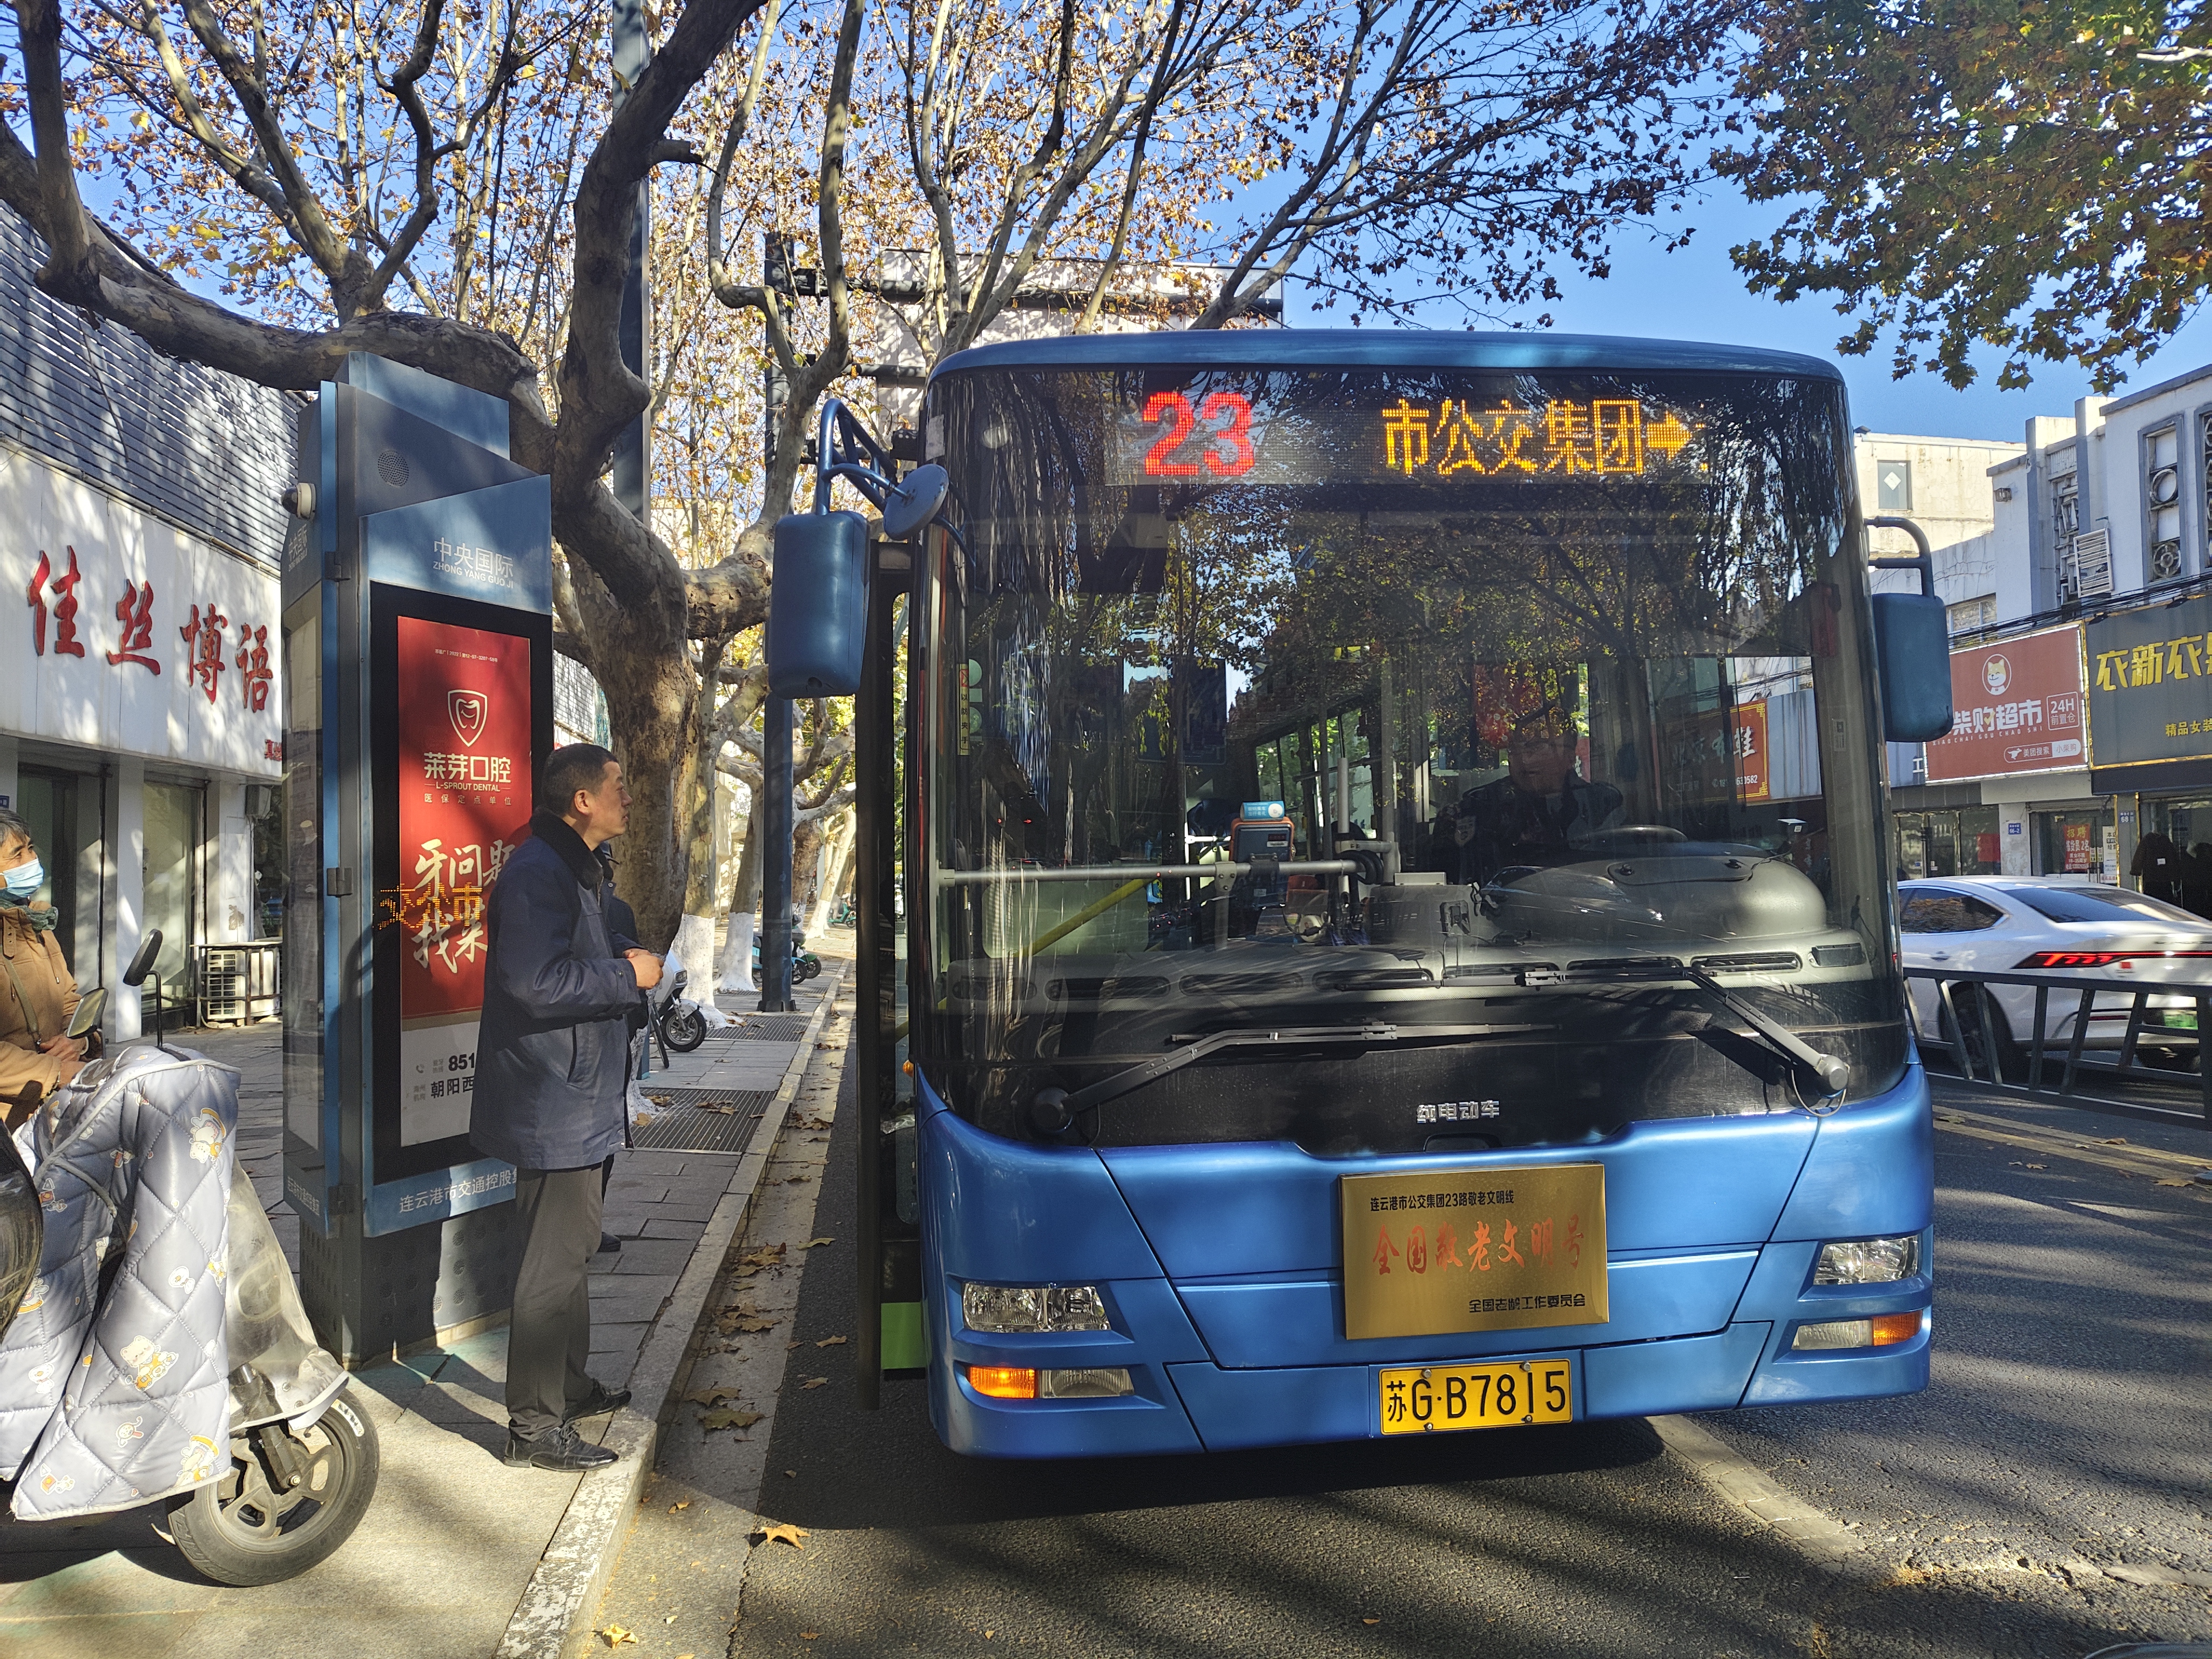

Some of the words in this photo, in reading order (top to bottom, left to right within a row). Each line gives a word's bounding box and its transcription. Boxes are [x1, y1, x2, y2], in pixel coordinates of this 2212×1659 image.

[1143, 392, 1254, 476] 23
[1382, 398, 1644, 476] 市公交集团
[434, 537, 514, 578] 中央国际
[433, 561, 463, 576] ZHONG
[464, 568, 486, 581] YANG
[488, 575, 505, 586] GUO
[507, 578, 514, 589] JI
[2096, 632, 2212, 691] 衣新衣
[2051, 698, 2074, 713] 24H
[1948, 699, 2042, 736] 柴购超市
[2051, 712, 2076, 725] 前置仓
[2165, 718, 2212, 737] 精品女装
[1999, 729, 2021, 737] CHAO
[2027, 725, 2043, 733] SHI
[2023, 746, 2050, 757] 美团搜索
[2056, 743, 2077, 753] 小柴购
[423, 751, 511, 783] 莱芽口腔
[436, 781, 472, 790] L-SPROUT
[473, 784, 501, 792] DENTAL
[424, 793, 511, 805] 医保定点单位
[2067, 826, 2086, 838] 招聘
[448, 1053, 475, 1071] 851
[431, 1076, 474, 1098] 朝阳西
[1417, 1100, 1500, 1124] 纯电动车
[1370, 1190, 1514, 1211] 连云港市公交集团23路敬老文明线
[1372, 1213, 1584, 1276] 全国敬老文明号
[1469, 1293, 1586, 1313] 全国老龄工作委员会
